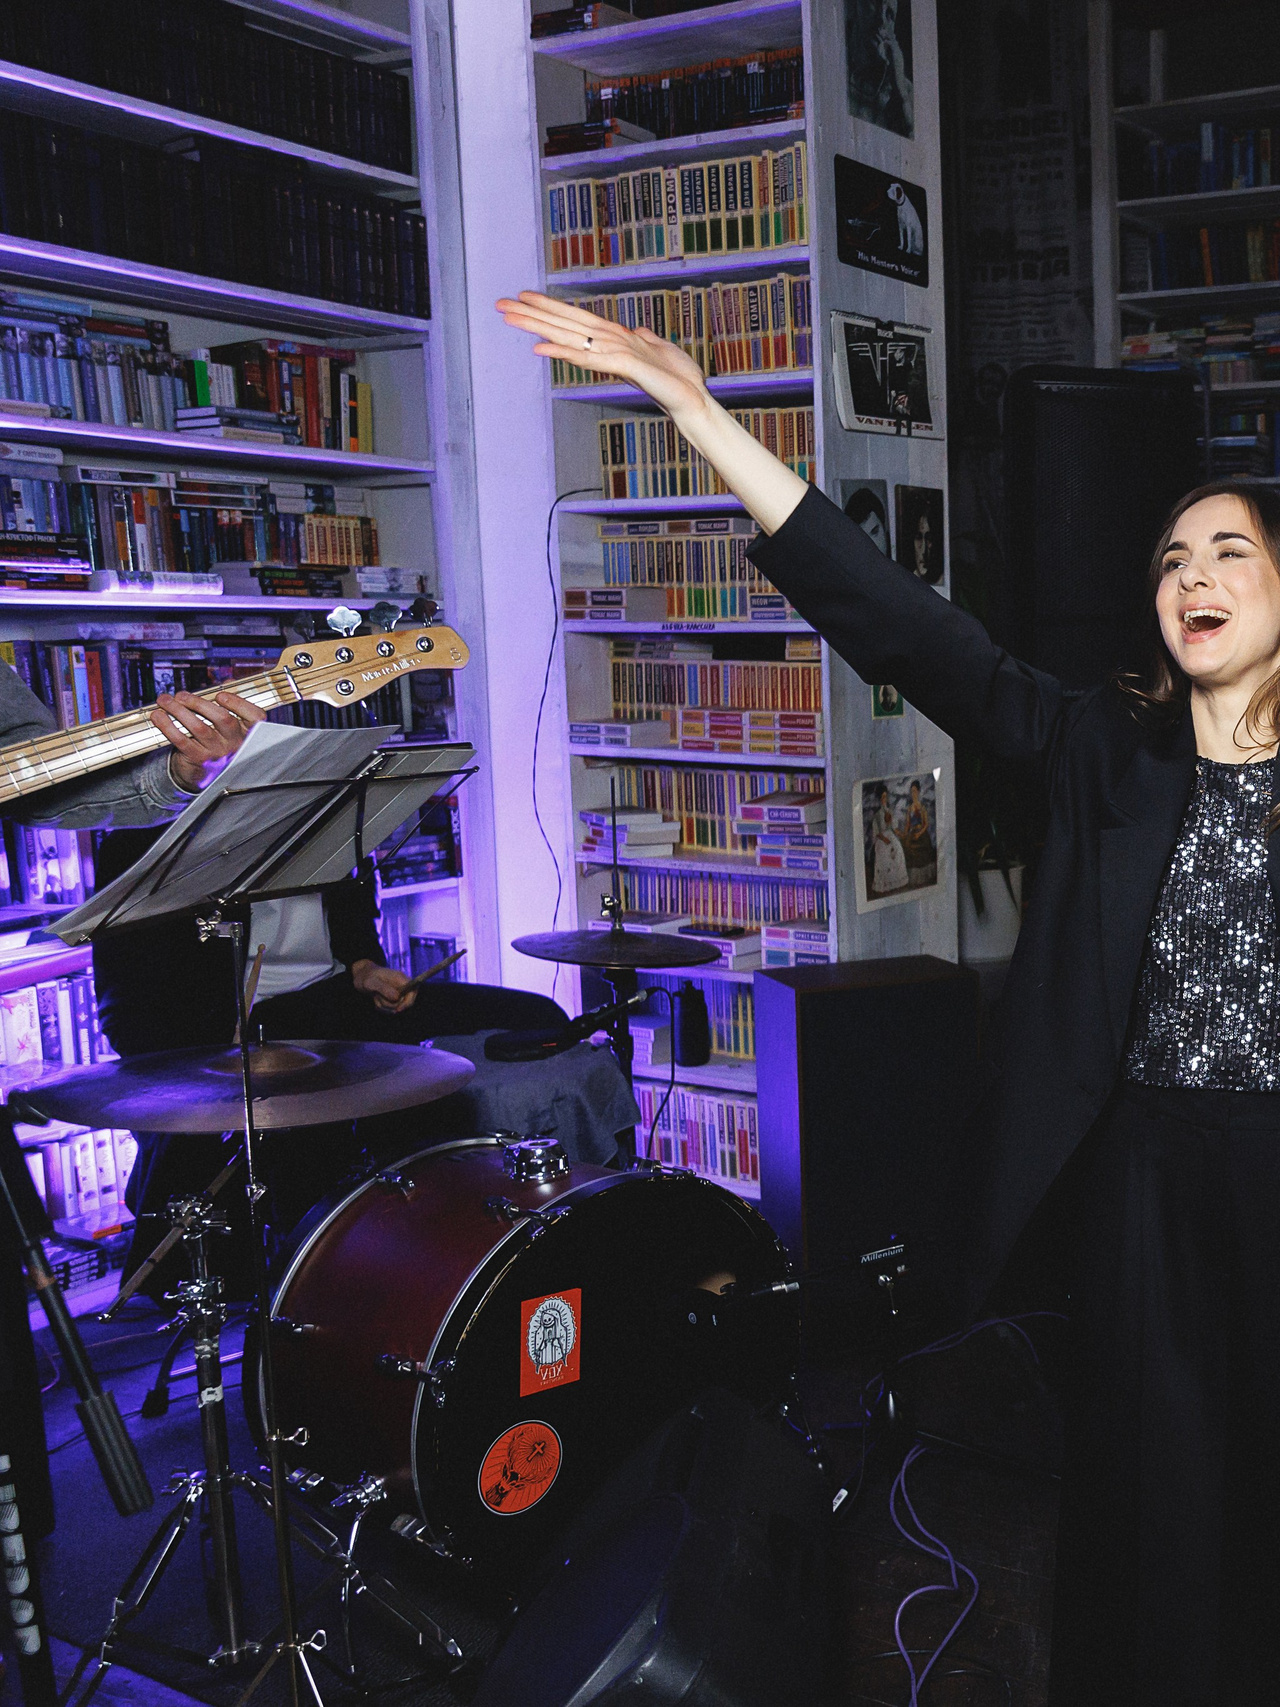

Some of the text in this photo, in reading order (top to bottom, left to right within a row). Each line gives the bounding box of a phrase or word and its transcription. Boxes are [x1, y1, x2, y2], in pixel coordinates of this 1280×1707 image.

[667, 180, 676, 223] БРОМ
[749, 289, 758, 327] ГОМЕР
[855, 416, 884, 427] VAN
[861, 1247, 904, 1264] Millenium
[540, 1364, 563, 1381] VOX
